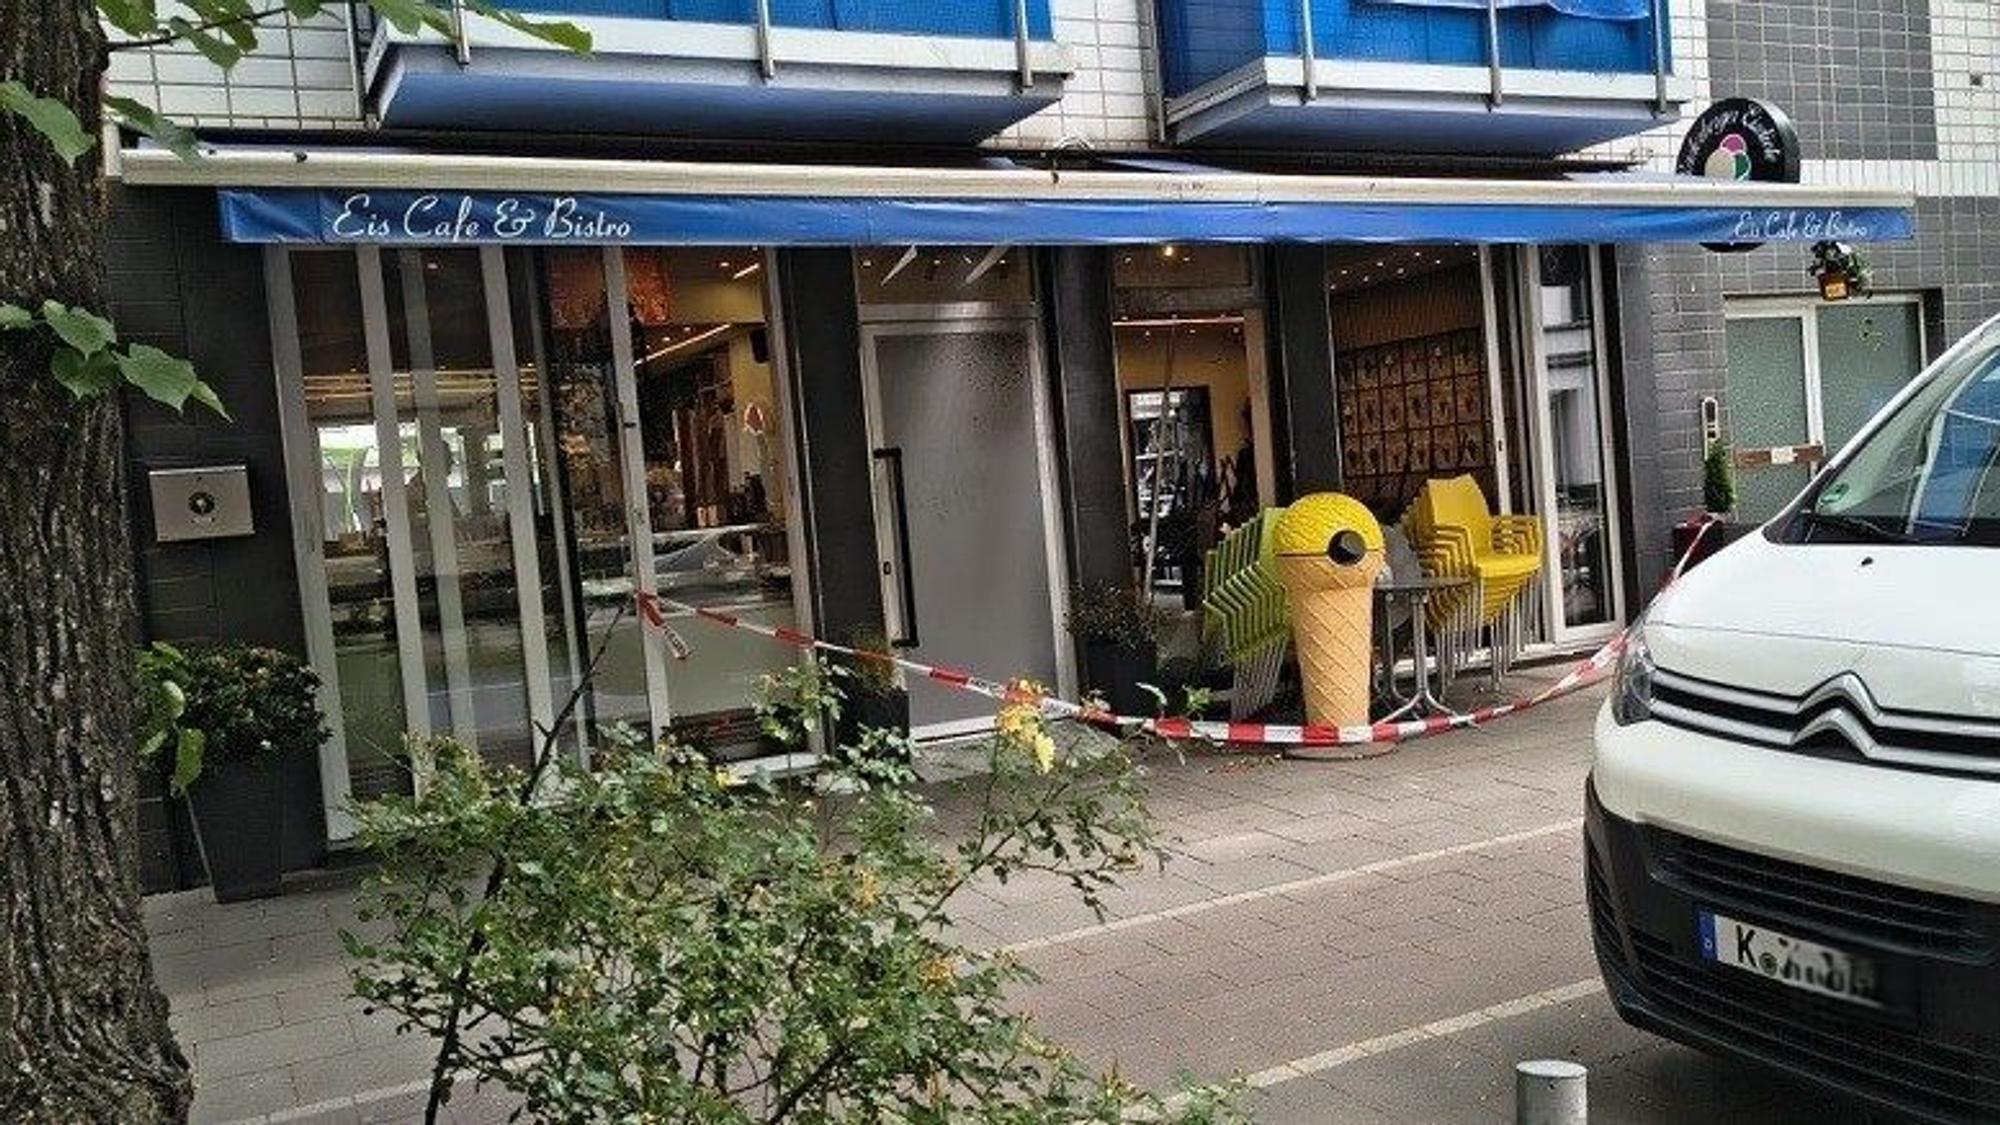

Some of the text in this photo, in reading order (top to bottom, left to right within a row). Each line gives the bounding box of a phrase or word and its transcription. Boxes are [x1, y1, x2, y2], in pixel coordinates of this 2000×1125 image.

[332, 193, 632, 243] Eis Cafe & Bistro
[1735, 211, 1760, 239] Eis
[1825, 211, 1869, 239] Bistro
[1735, 924, 1758, 968] K
